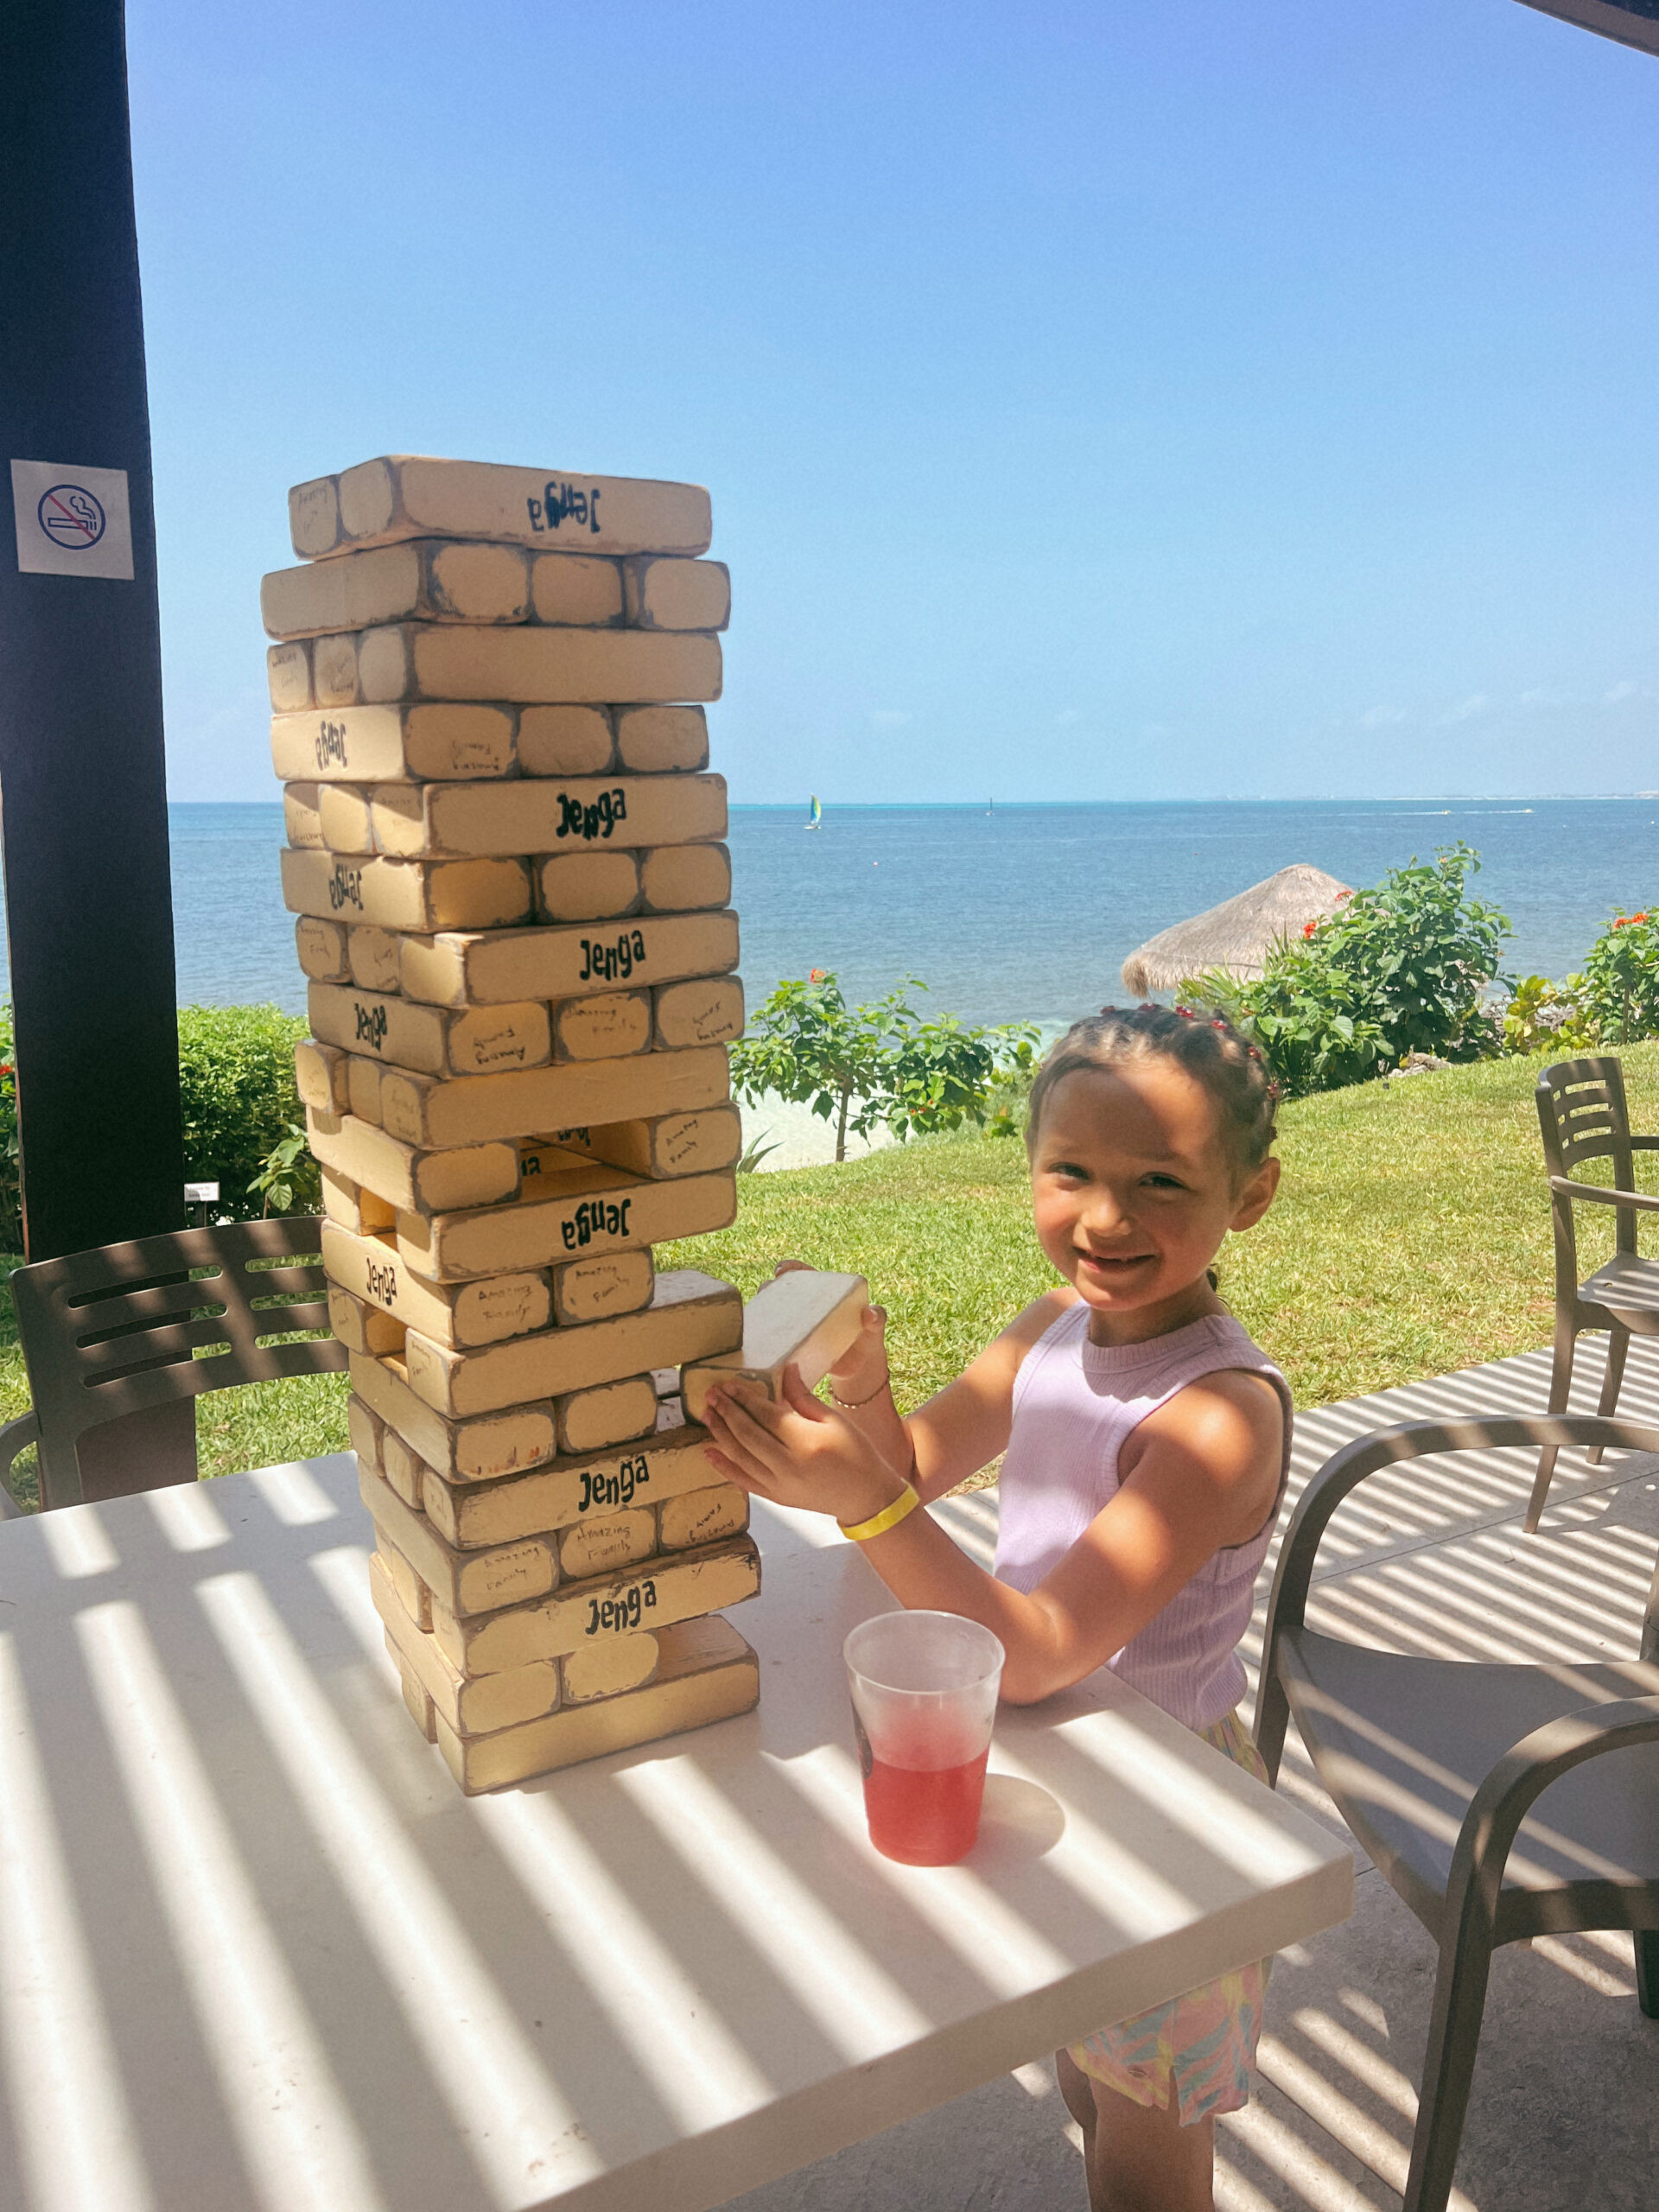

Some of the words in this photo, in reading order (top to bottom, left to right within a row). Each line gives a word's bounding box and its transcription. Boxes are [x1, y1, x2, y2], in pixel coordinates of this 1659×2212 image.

[527, 481, 601, 533] Jenga
[315, 721, 347, 771] Jenga
[556, 788, 626, 841] Jenga
[329, 863, 364, 911] Jenga
[579, 930, 645, 982] Jenga
[354, 1003, 387, 1052] Jenga
[562, 1198, 631, 1250] Jenga
[366, 1257, 397, 1306] Jenga
[578, 1455, 650, 1512] Jenga
[585, 1580, 657, 1635] Jenga
